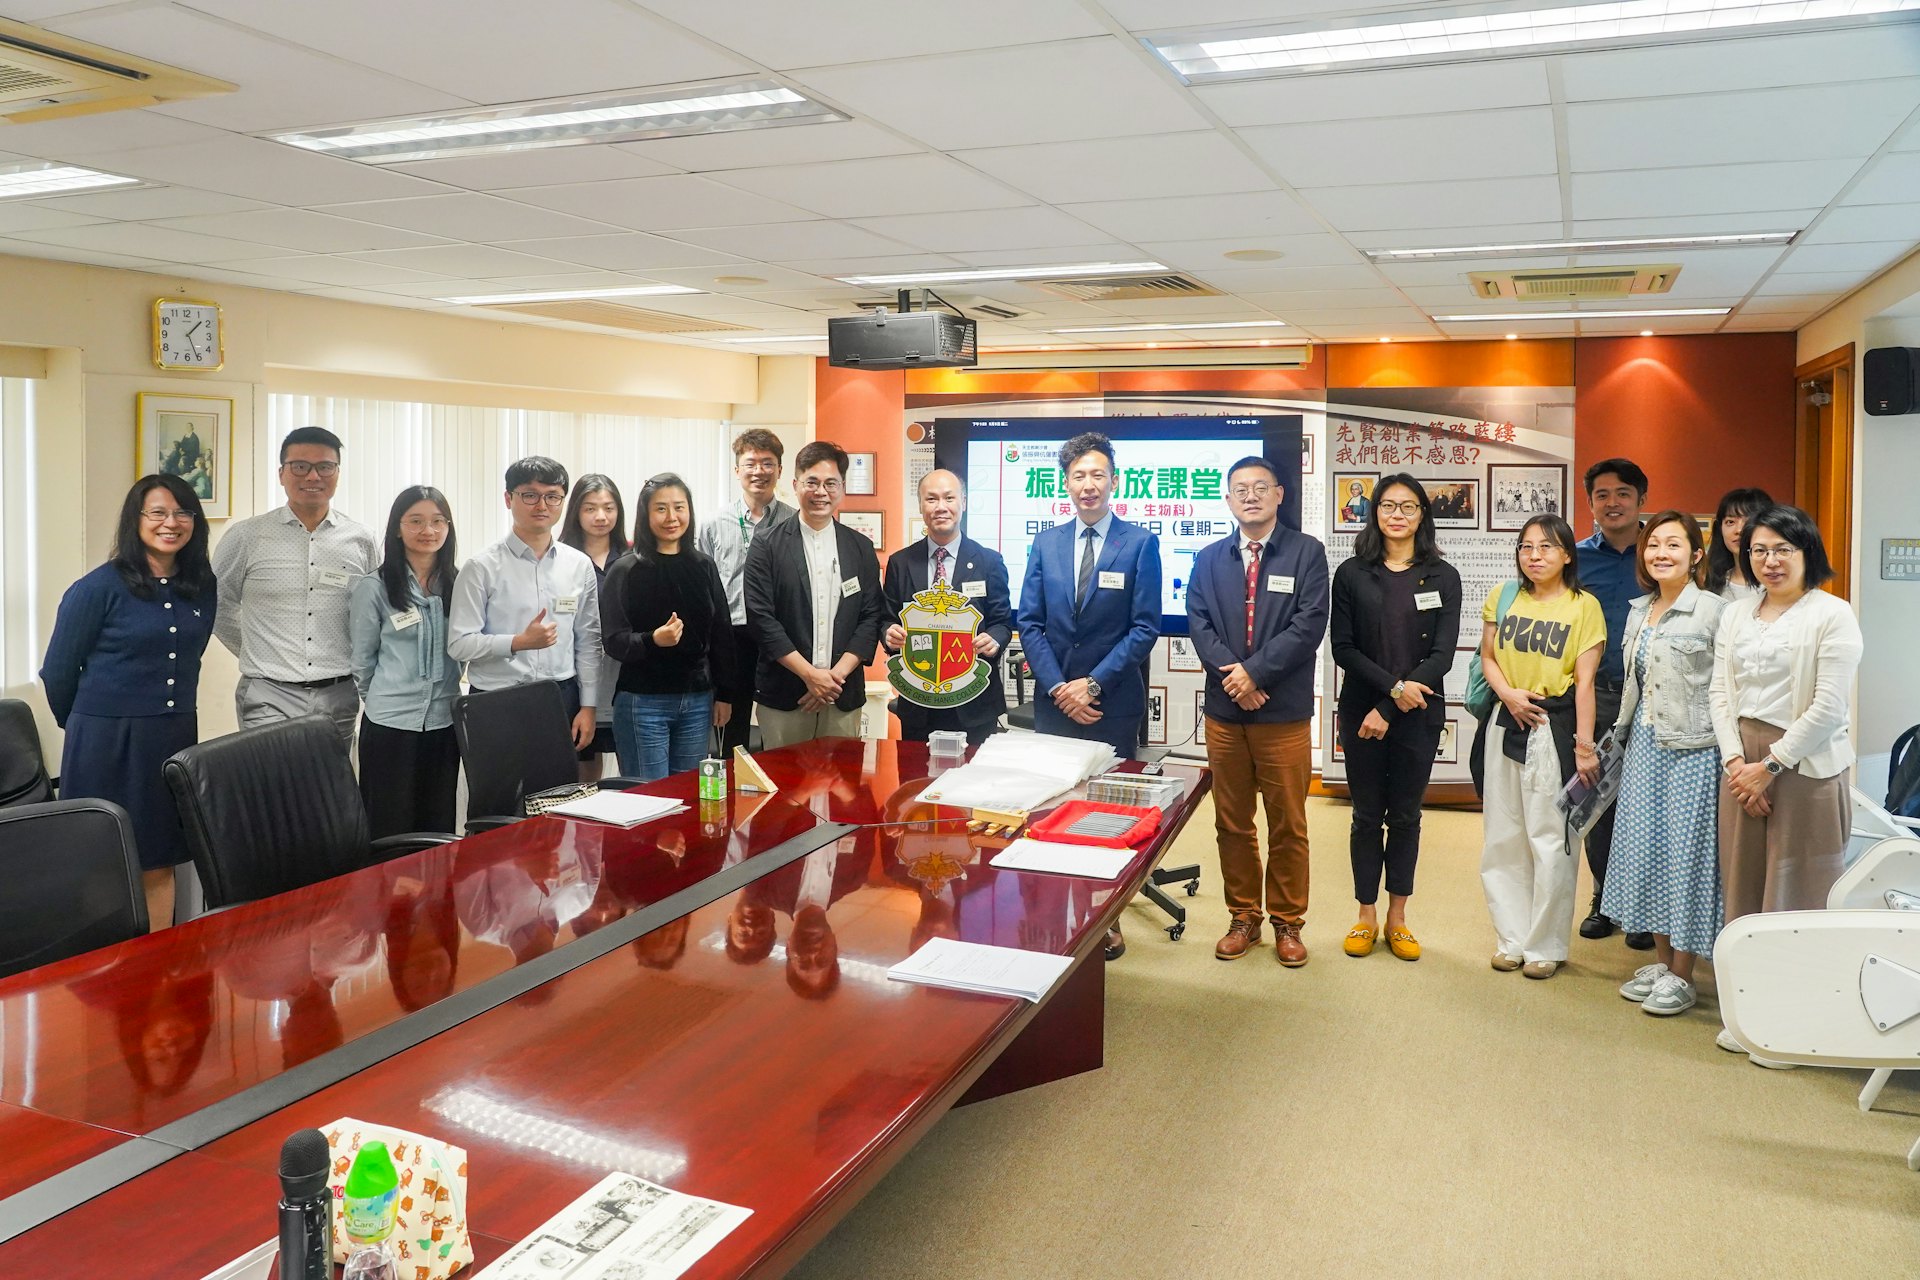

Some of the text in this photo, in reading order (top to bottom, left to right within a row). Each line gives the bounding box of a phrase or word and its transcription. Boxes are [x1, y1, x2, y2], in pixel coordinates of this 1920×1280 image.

[171, 309, 178, 317] 11
[183, 309, 191, 318] 12
[162, 317, 170, 326] 10
[205, 320, 211, 328] 2
[161, 330, 168, 338] 9
[206, 333, 212, 341] 3
[163, 343, 169, 351] 8
[173, 352, 179, 360] 7
[184, 353, 191, 361] 6
[1025, 467, 1222, 500] 振放課堂
[1499, 614, 1571, 660] PLAY
[891, 673, 985, 704] CHONG GENE HANG COLLEGE
[354, 1219, 374, 1228] Care
